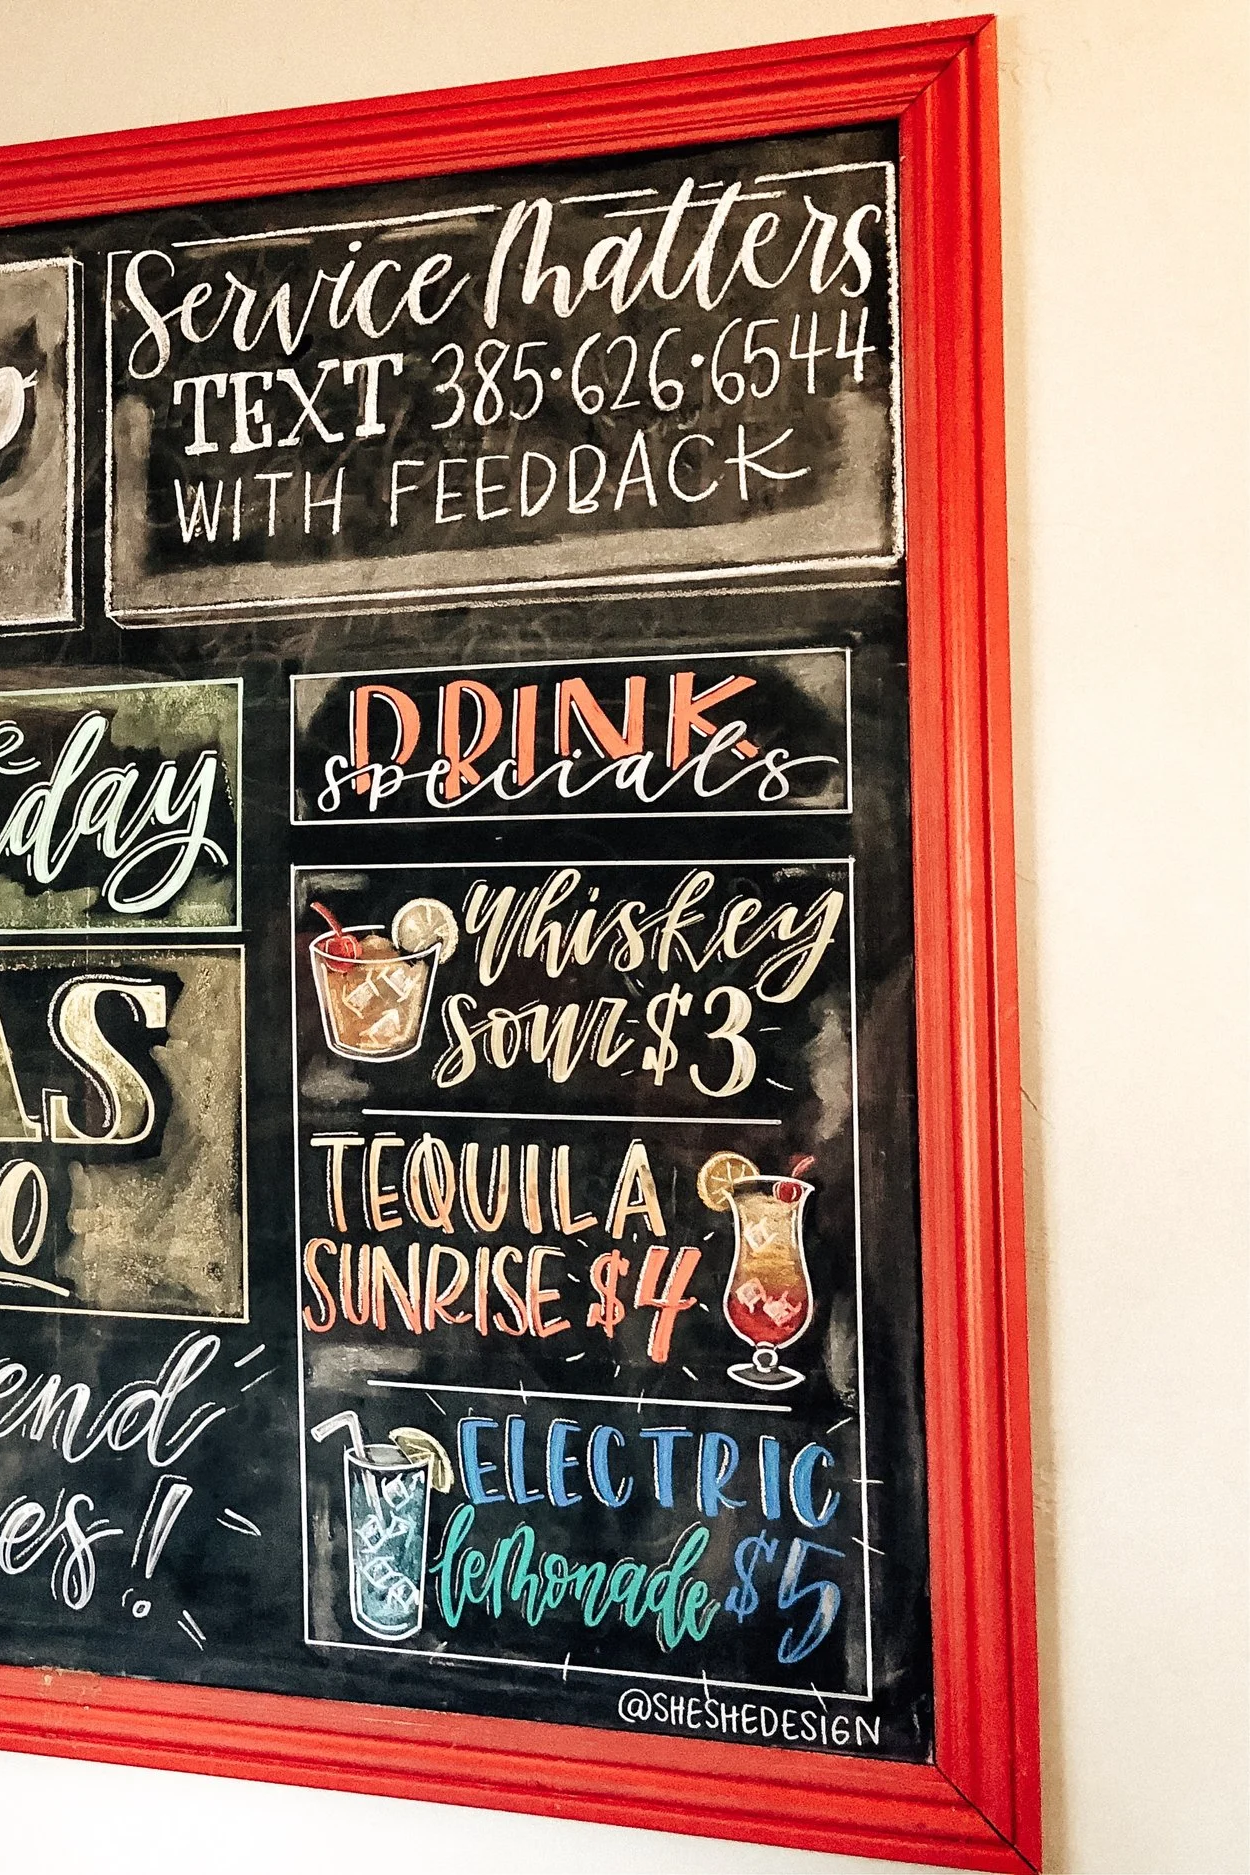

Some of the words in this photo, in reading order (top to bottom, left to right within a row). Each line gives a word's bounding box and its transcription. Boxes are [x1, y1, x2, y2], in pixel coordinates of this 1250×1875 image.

[122, 238, 472, 380] Service
[482, 176, 883, 331] Matters
[172, 352, 403, 456] TEXT
[173, 466, 347, 544] WITH
[389, 424, 812, 527] FEEDBACK
[317, 720, 840, 812] specials
[349, 671, 763, 801] DRINK
[640, 982, 760, 1100] $3
[309, 1131, 668, 1240] TEQUILA
[302, 1237, 572, 1338] SUNRISE
[585, 1245, 702, 1364] $4
[457, 1414, 843, 1530] ELECTRIC
[429, 1502, 722, 1654] lemonade
[724, 1530, 846, 1666] $5
[616, 1687, 881, 1748] @SHESHEDESIGN
